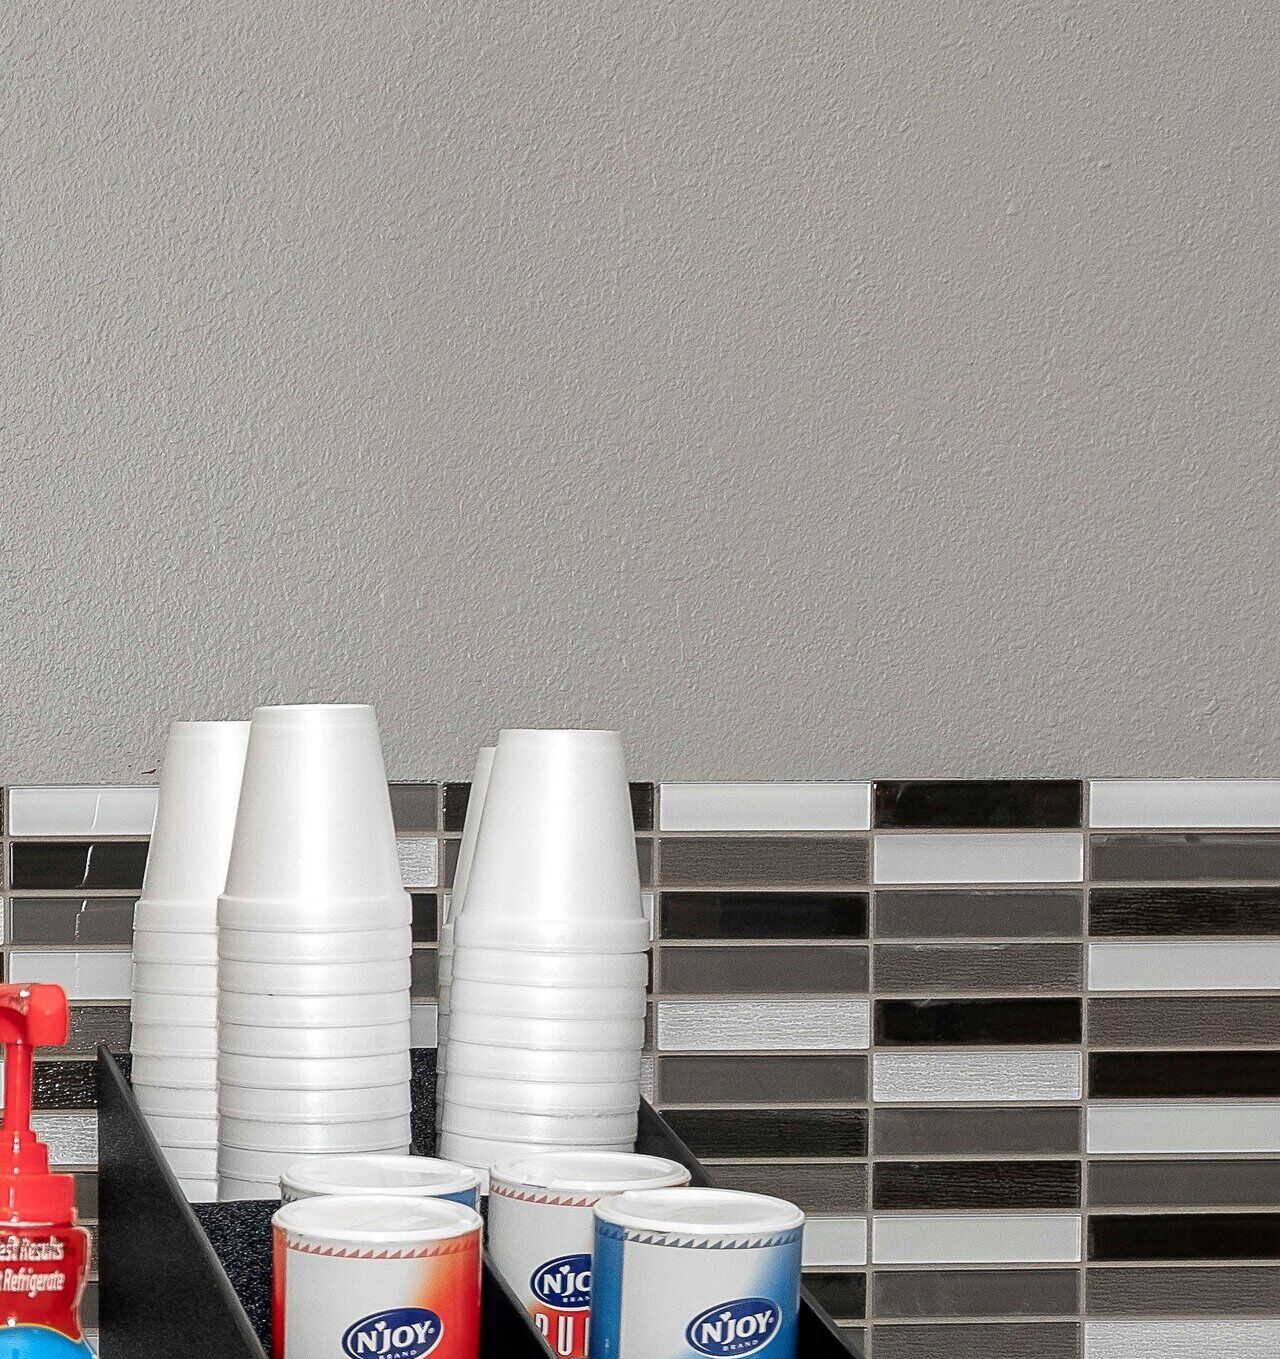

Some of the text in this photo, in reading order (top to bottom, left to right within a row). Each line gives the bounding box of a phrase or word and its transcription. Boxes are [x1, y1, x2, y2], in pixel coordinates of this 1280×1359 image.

[19, 1234, 65, 1261] Results
[3, 1266, 65, 1298] Refrigerate
[722, 1339, 759, 1351] BRAND
